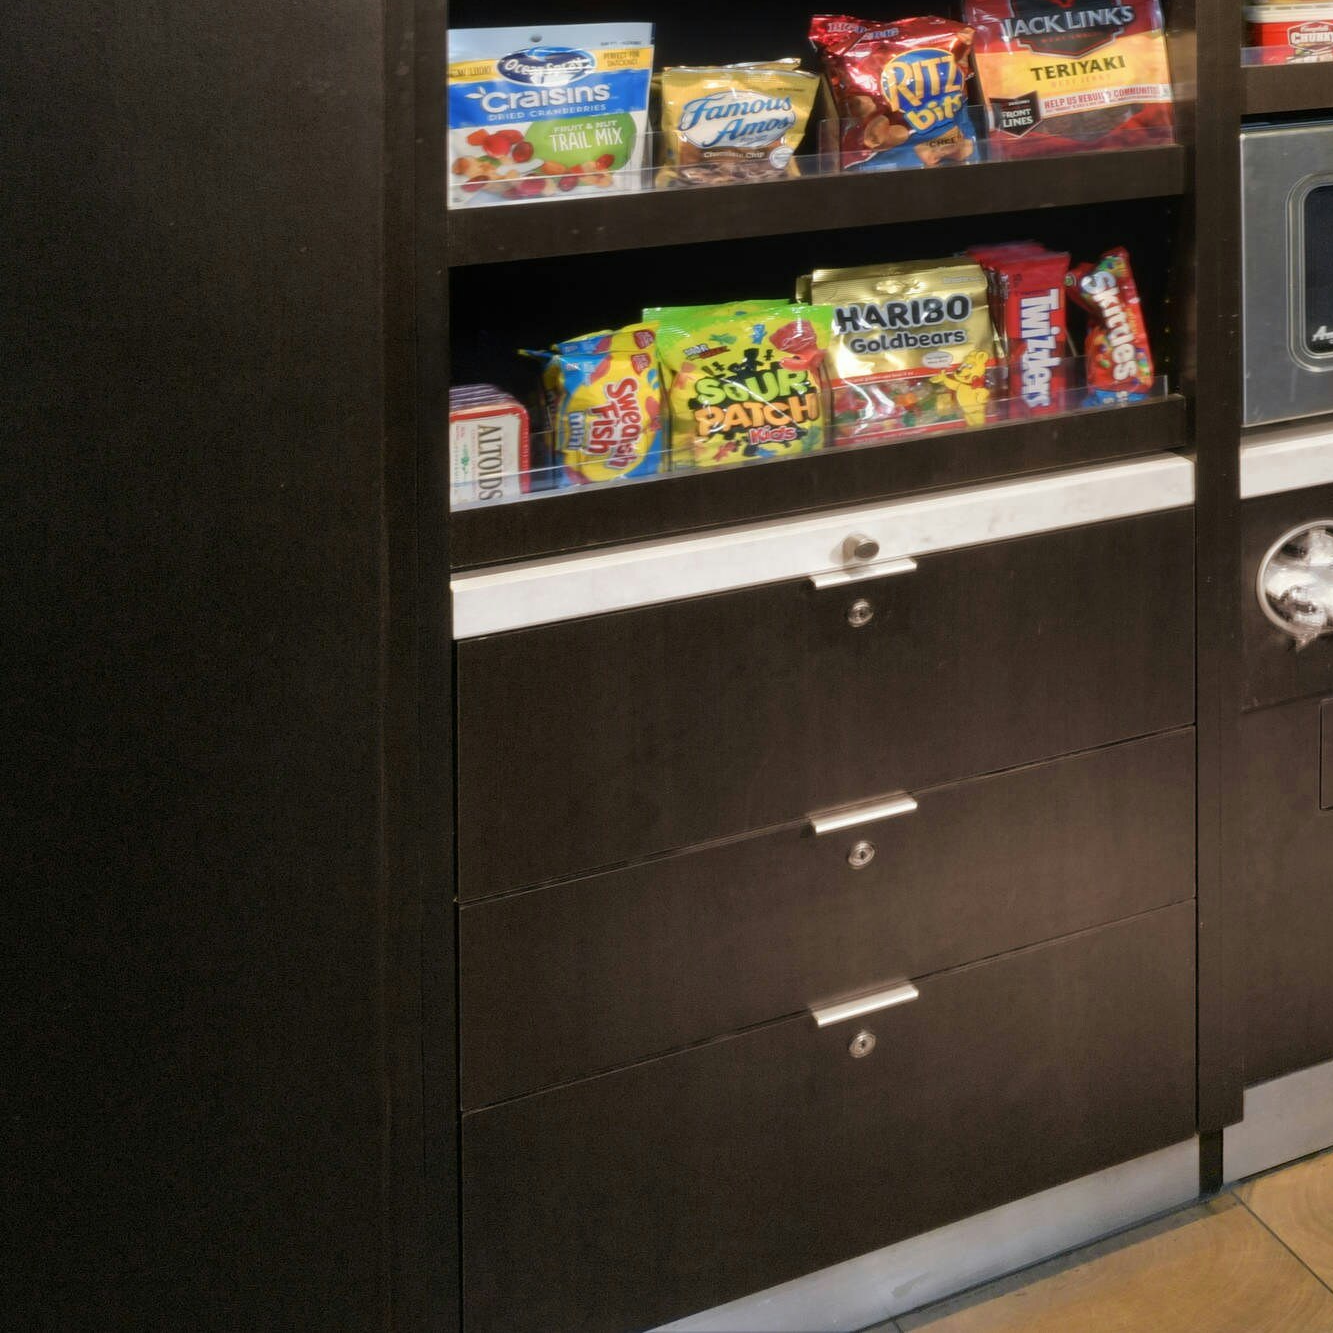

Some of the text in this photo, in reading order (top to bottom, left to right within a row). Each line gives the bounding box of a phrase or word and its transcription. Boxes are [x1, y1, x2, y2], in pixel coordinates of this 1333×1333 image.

[1000, 13, 1067, 40] JACK
[1065, 5, 1135, 31] LINK'S
[884, 55, 962, 112] RITZ
[1030, 54, 1127, 82] TERIYAKI
[480, 82, 612, 114] Craisins
[487, 103, 607, 122] DRIED CRANBERRIES
[677, 95, 792, 132] Famous
[906, 93, 962, 131] bits
[1002, 108, 1031, 119] FRONT
[1044, 97, 1065, 110] HELP
[1066, 95, 1078, 106] US
[552, 119, 618, 134] FRUIT & NUT
[701, 117, 794, 148] Amos
[1002, 115, 1034, 128] LINES
[548, 126, 623, 153] TRAIL MIX
[834, 294, 971, 333] HARIBO
[1080, 270, 1138, 381] Skittles
[849, 330, 966, 355] Goldbears
[1020, 287, 1062, 408] Twizzlers
[695, 370, 810, 406] SOUR
[588, 402, 620, 456] Fish
[605, 377, 642, 469] Swedish
[694, 392, 820, 437] PATCH
[749, 425, 797, 445] Kids
[477, 425, 503, 501] ALTOIDS
